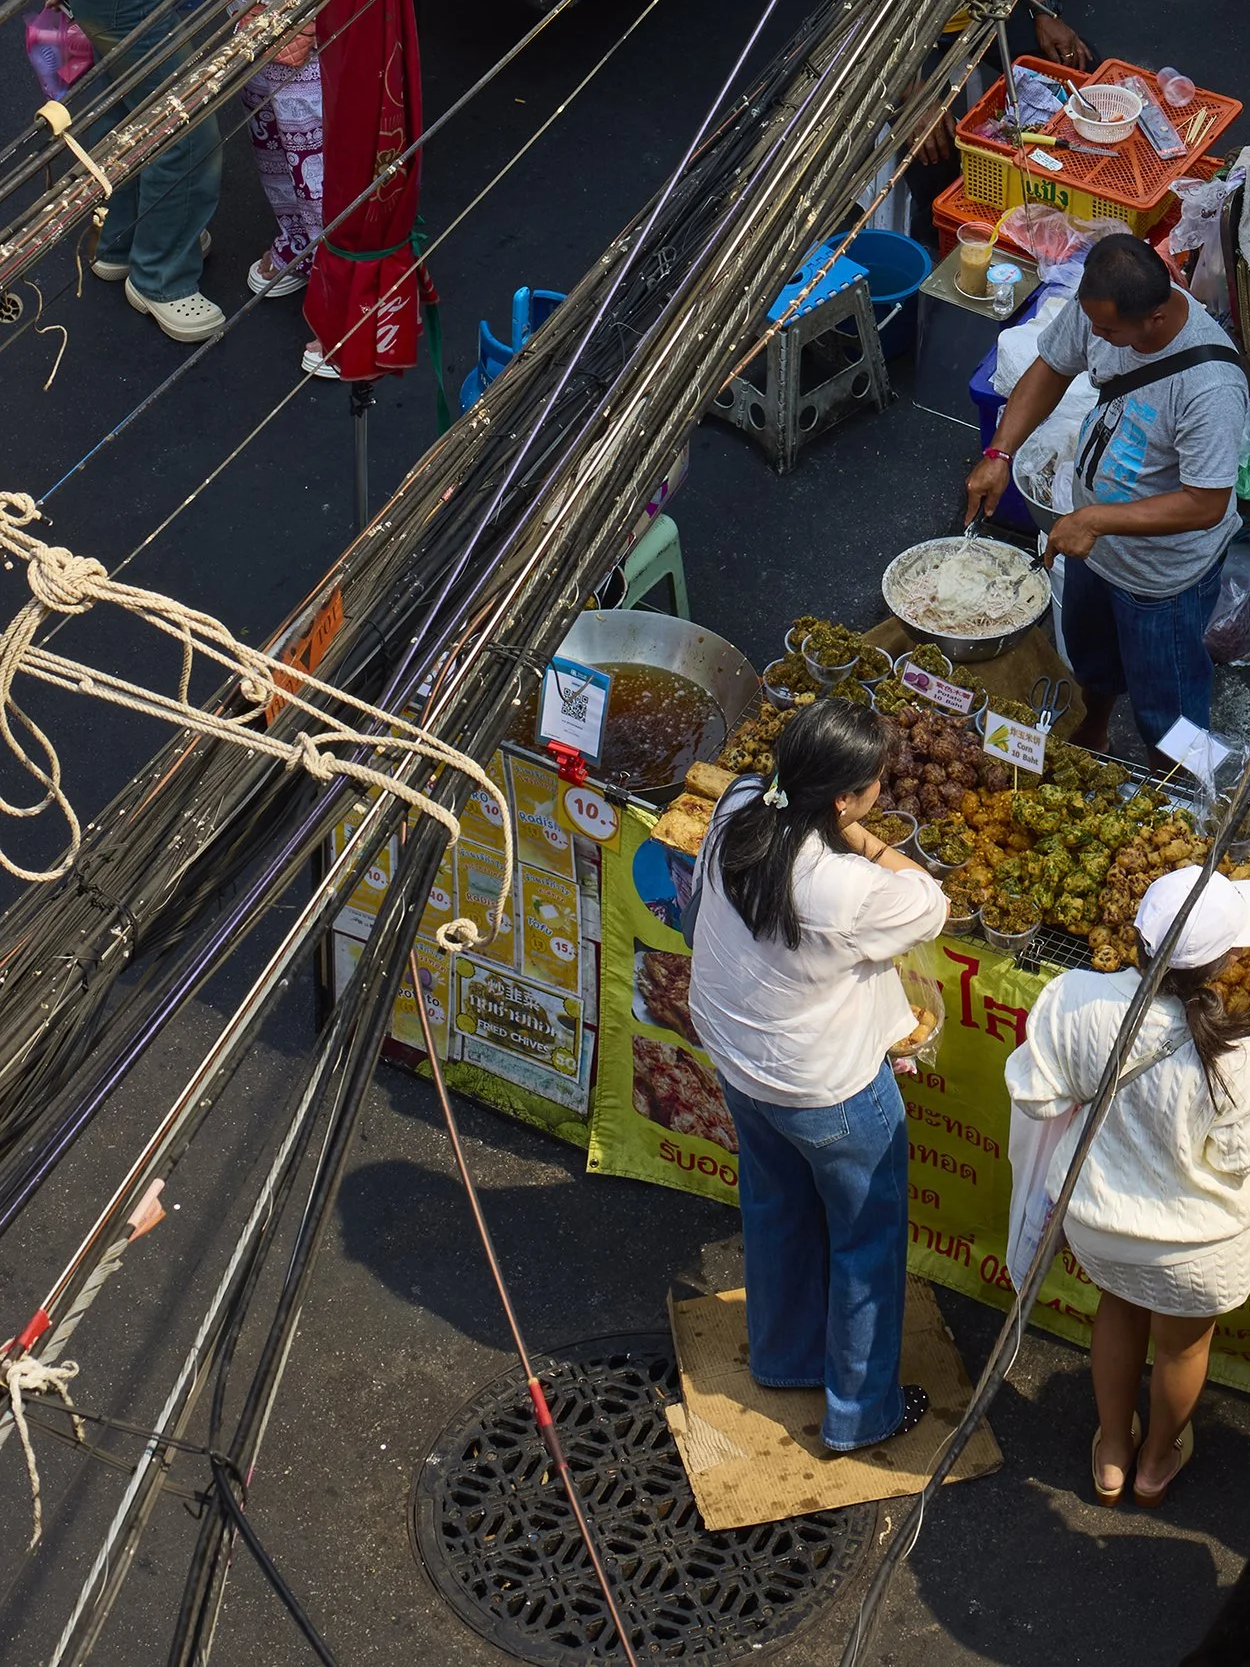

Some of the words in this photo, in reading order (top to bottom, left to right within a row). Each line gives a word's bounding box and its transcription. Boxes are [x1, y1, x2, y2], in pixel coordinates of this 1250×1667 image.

[933, 694, 943, 702] 10
[945, 698, 964, 710] Baht
[937, 689, 963, 704] Potato
[1017, 741, 1033, 754] Corn
[1011, 749, 1021, 759] 10
[1022, 753, 1039, 766] Baht
[527, 916, 553, 936] Tofu
[477, 1018, 508, 1038] FRIED
[510, 1031, 551, 1055] CHIVES
